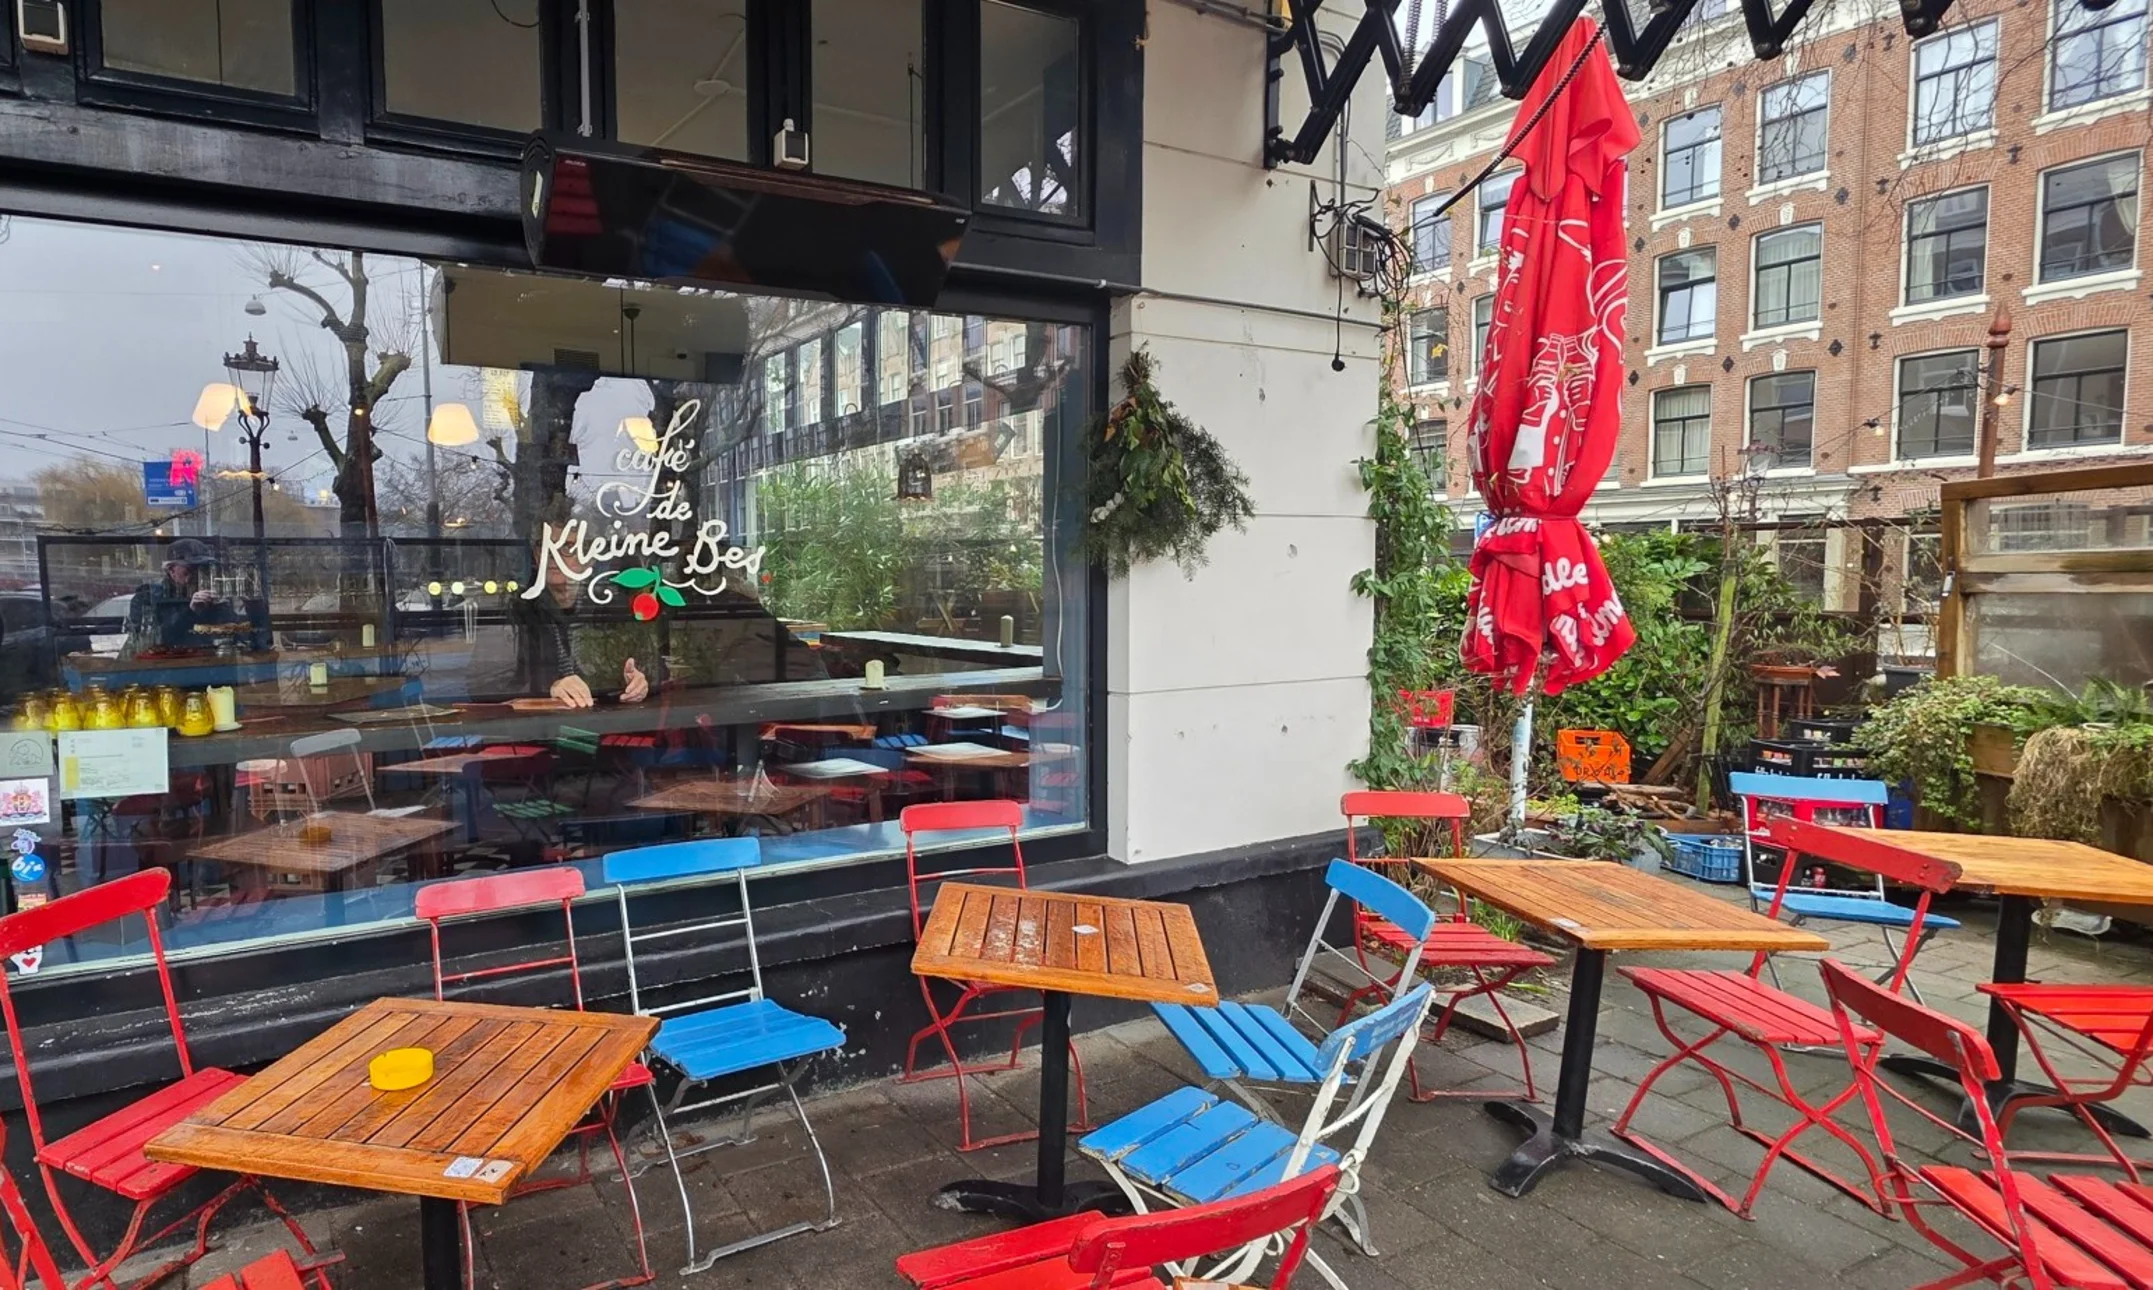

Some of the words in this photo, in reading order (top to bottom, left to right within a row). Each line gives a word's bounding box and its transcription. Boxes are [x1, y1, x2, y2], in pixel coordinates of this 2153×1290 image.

[634, 480, 693, 521] de
[520, 518, 680, 600] Kleine
[684, 518, 767, 575] Bes
